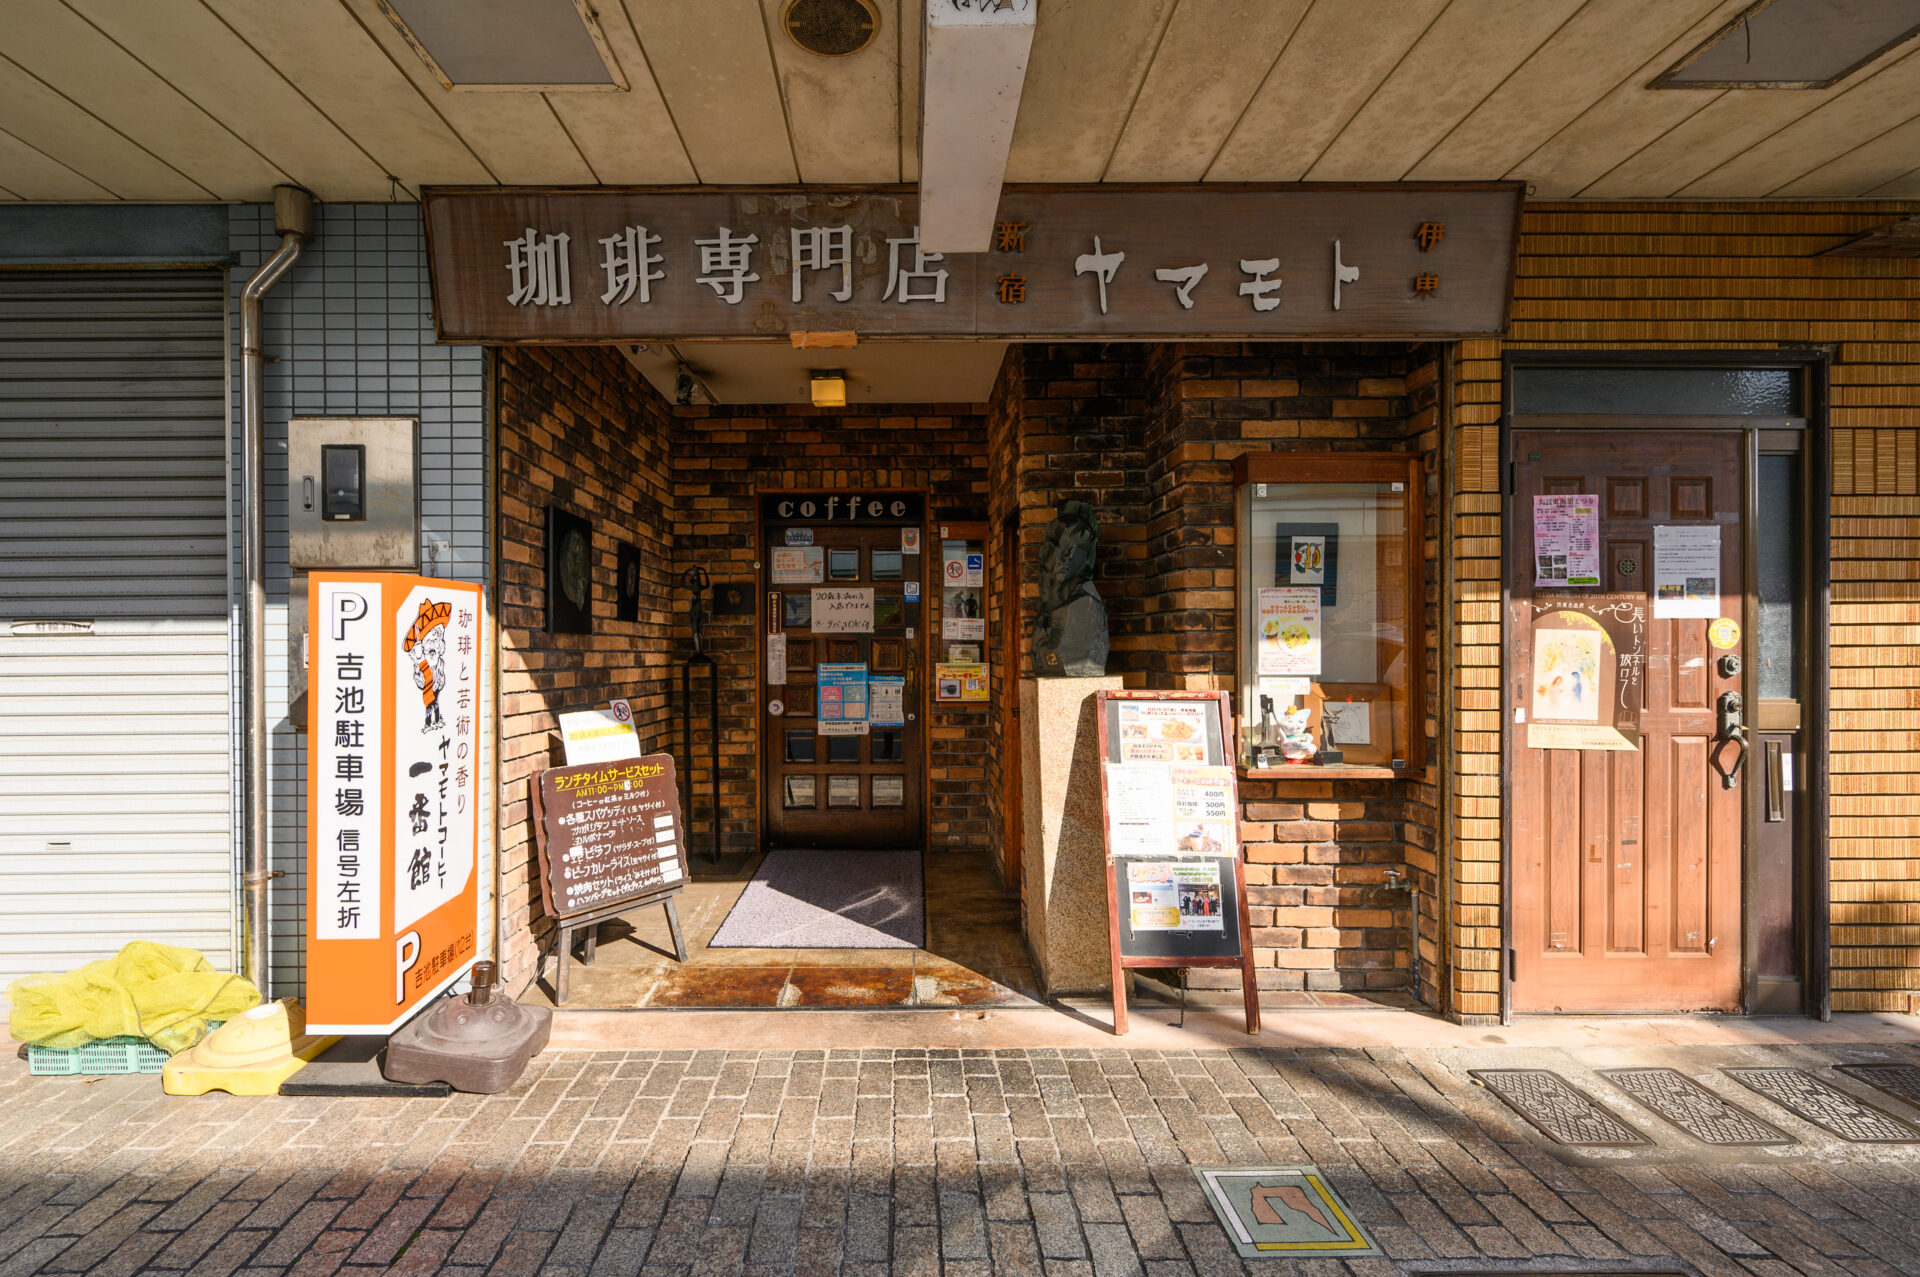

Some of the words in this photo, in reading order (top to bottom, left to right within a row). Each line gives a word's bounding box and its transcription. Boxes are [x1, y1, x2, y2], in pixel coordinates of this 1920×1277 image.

[503, 225, 948, 306] 珈琲専門店
[997, 221, 1028, 304] 新宿
[1075, 235, 1359, 314] ヤマモト
[1415, 221, 1446, 300] 伊東
[778, 496, 906, 521] coffee
[332, 592, 368, 641] P
[1631, 607, 1646, 686] 長いトンネルを
[453, 607, 473, 815] 珈琲と芸術の香り
[1619, 654, 1632, 710] 抜けて
[334, 653, 365, 818] 吉池駐車場
[436, 734, 451, 891] ヤマモトコーヒー
[555, 765, 664, 790] ランチタイムサービスセット
[408, 760, 432, 892] 一番館
[336, 828, 361, 930] 信号左折
[396, 930, 421, 1005] P
